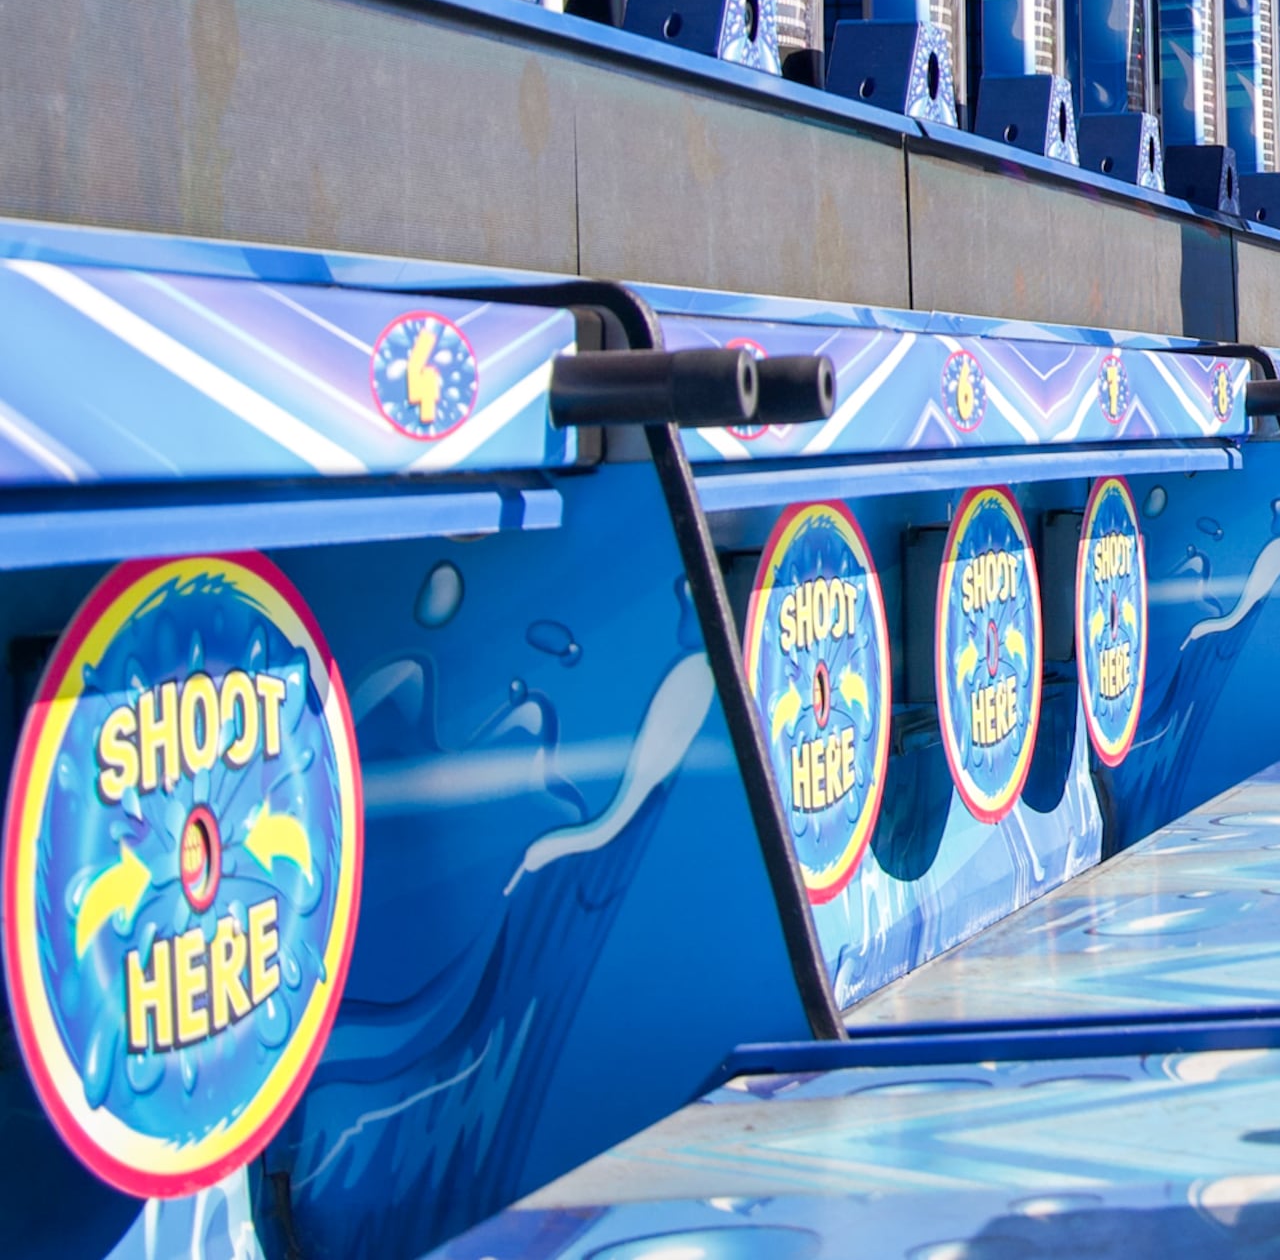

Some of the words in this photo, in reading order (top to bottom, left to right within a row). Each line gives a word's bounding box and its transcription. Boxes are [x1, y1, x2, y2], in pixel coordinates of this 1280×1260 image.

[956, 361, 974, 422] 6
[961, 549, 1018, 614] SHOOT
[1094, 531, 1131, 583] SHOOT
[778, 575, 858, 654] SHOOT
[1099, 640, 1130, 702] HERE
[96, 669, 288, 805] SHOOT
[971, 675, 1018, 749] HERE
[791, 726, 856, 815] HERE
[126, 898, 281, 1056] HERE
